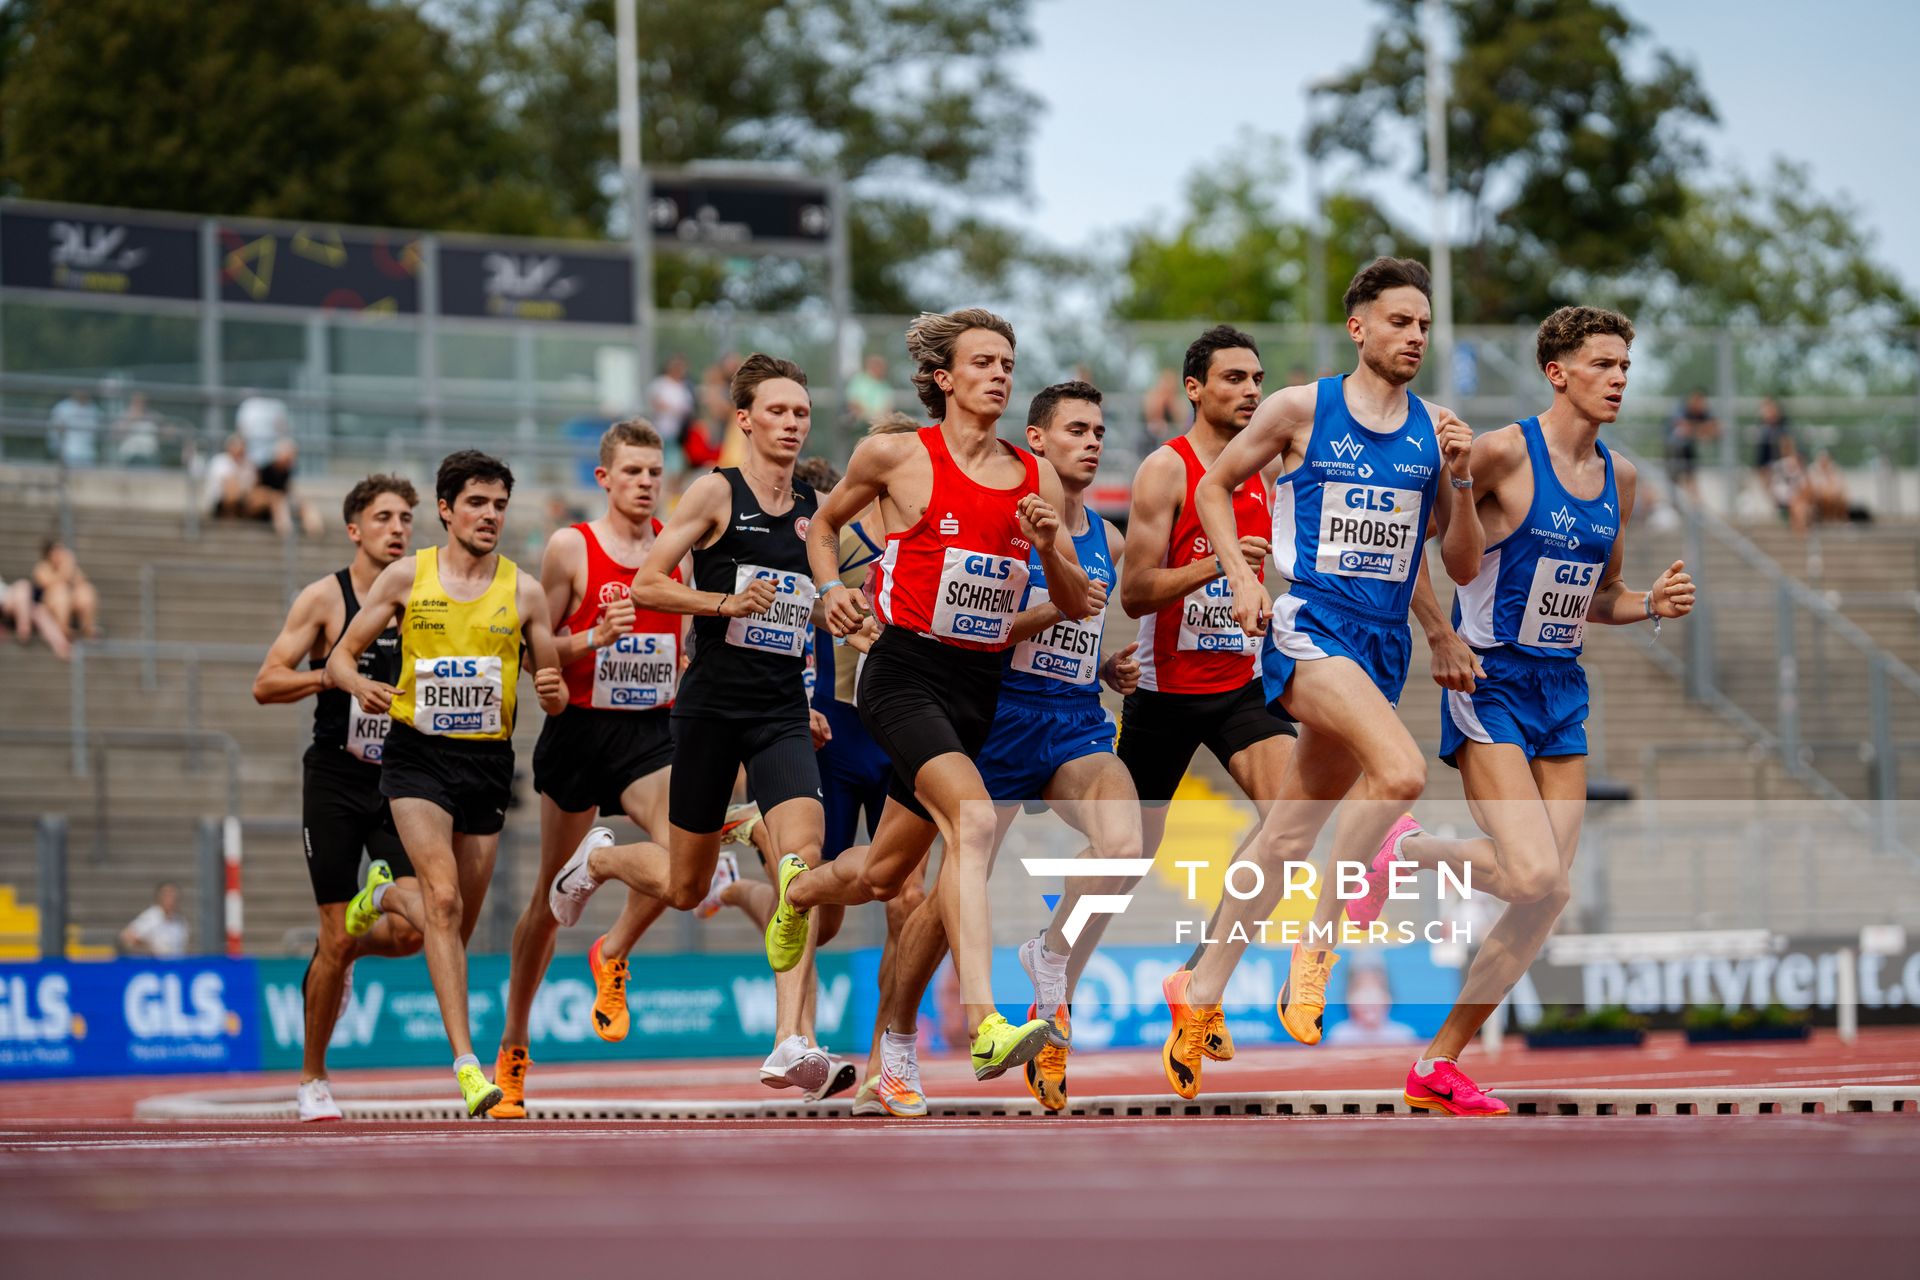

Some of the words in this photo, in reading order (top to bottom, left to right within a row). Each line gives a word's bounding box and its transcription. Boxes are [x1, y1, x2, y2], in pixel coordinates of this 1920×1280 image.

[1311, 460, 1355, 469] STADTWERKE
[1393, 463, 1433, 476] VIACTIV
[1326, 469, 1355, 477] BOCHUM
[1329, 517, 1411, 549] PROBST
[1362, 555, 1391, 567] PLAN
[945, 581, 1015, 614] SCHREML
[747, 601, 810, 629] LSMEYER
[975, 620, 999, 632] PLAN
[765, 631, 792, 644] PLAN
[1218, 637, 1242, 647] PLAN
[599, 660, 673, 683] SV.WAGNER
[1053, 658, 1078, 672] PLAN
[424, 686, 495, 707] BENITZ
[454, 715, 480, 724] PLAN
[0, 973, 86, 1039] LS.
